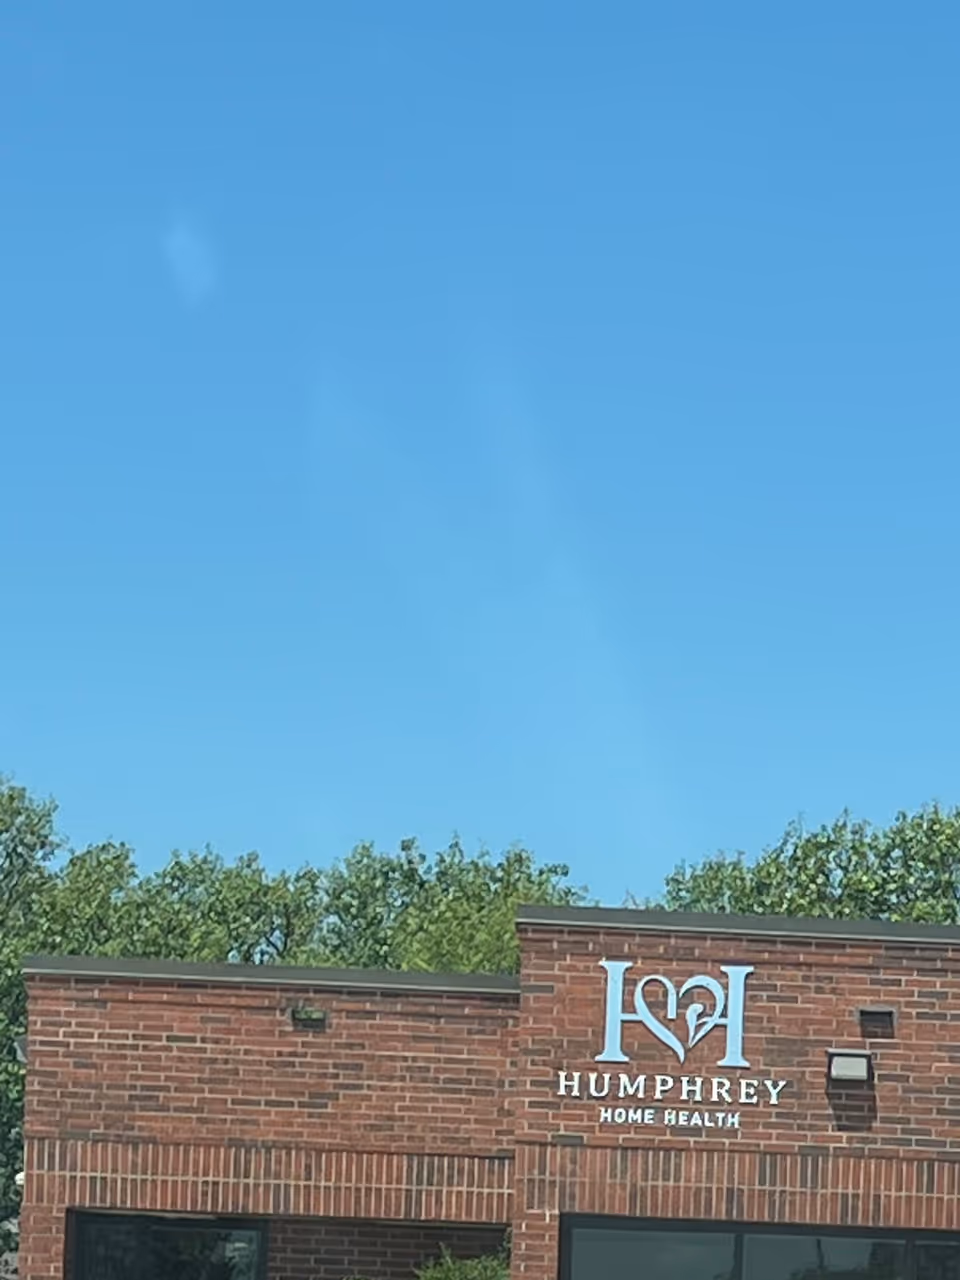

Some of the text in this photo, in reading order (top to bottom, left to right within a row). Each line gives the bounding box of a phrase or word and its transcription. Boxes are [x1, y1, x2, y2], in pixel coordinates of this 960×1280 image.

[557, 1071, 787, 1105] HUMPHREY
[600, 1107, 741, 1129] HOME HEALTH
